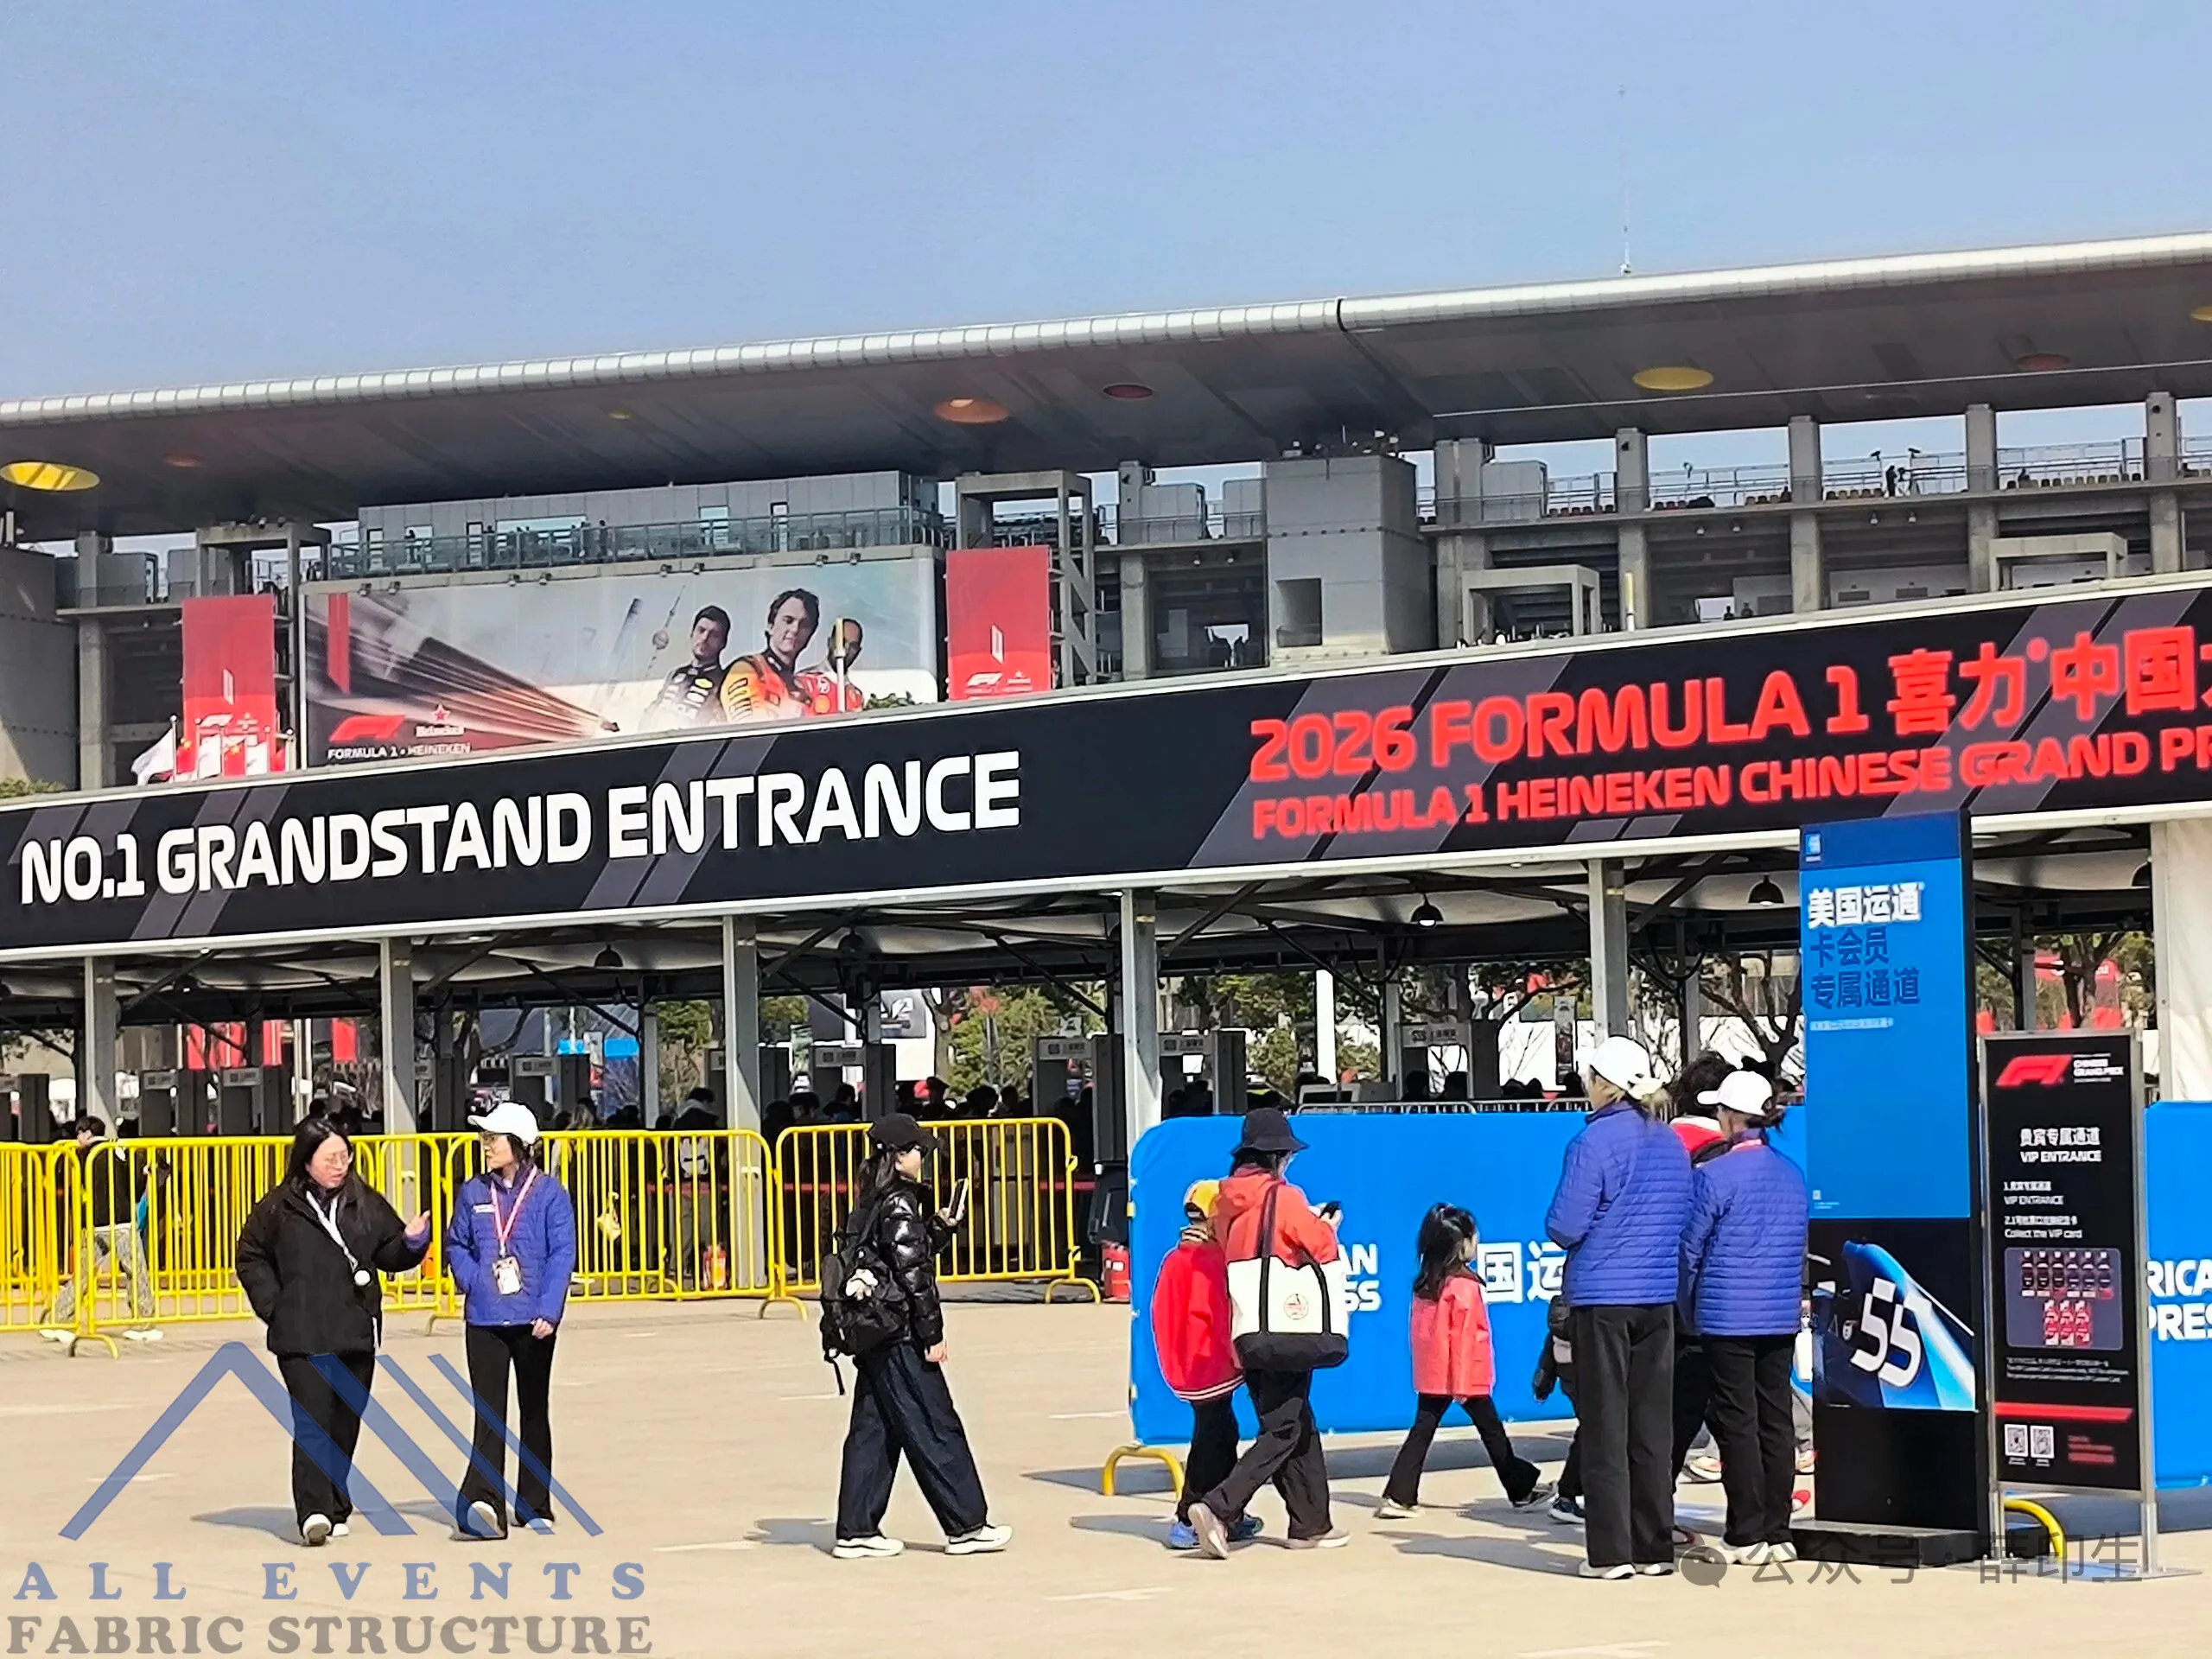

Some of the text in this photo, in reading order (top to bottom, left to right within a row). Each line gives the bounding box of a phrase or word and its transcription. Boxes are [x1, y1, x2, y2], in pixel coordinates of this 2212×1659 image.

[1250, 706, 1417, 782] 2026
[1431, 671, 1811, 767] FORMULA
[1826, 665, 1869, 734] 1
[327, 747, 388, 760] FORMULA
[1251, 785, 1458, 839] FORMULA
[1465, 785, 1489, 823] 1
[1496, 765, 1730, 820] HEINEKEN
[1740, 747, 1951, 803] CHINESE
[1960, 733, 2150, 787] GRAND
[22, 751, 1020, 905] NO.1 GRANDSTAND ENTRANCE
[1808, 883, 1922, 928] 美国运通
[1809, 927, 1890, 969] 卡会员
[1811, 968, 1920, 1009] 专属通道
[2019, 1150, 2102, 1163] VIP ENTRANCE
[1850, 1277, 1932, 1387] 55
